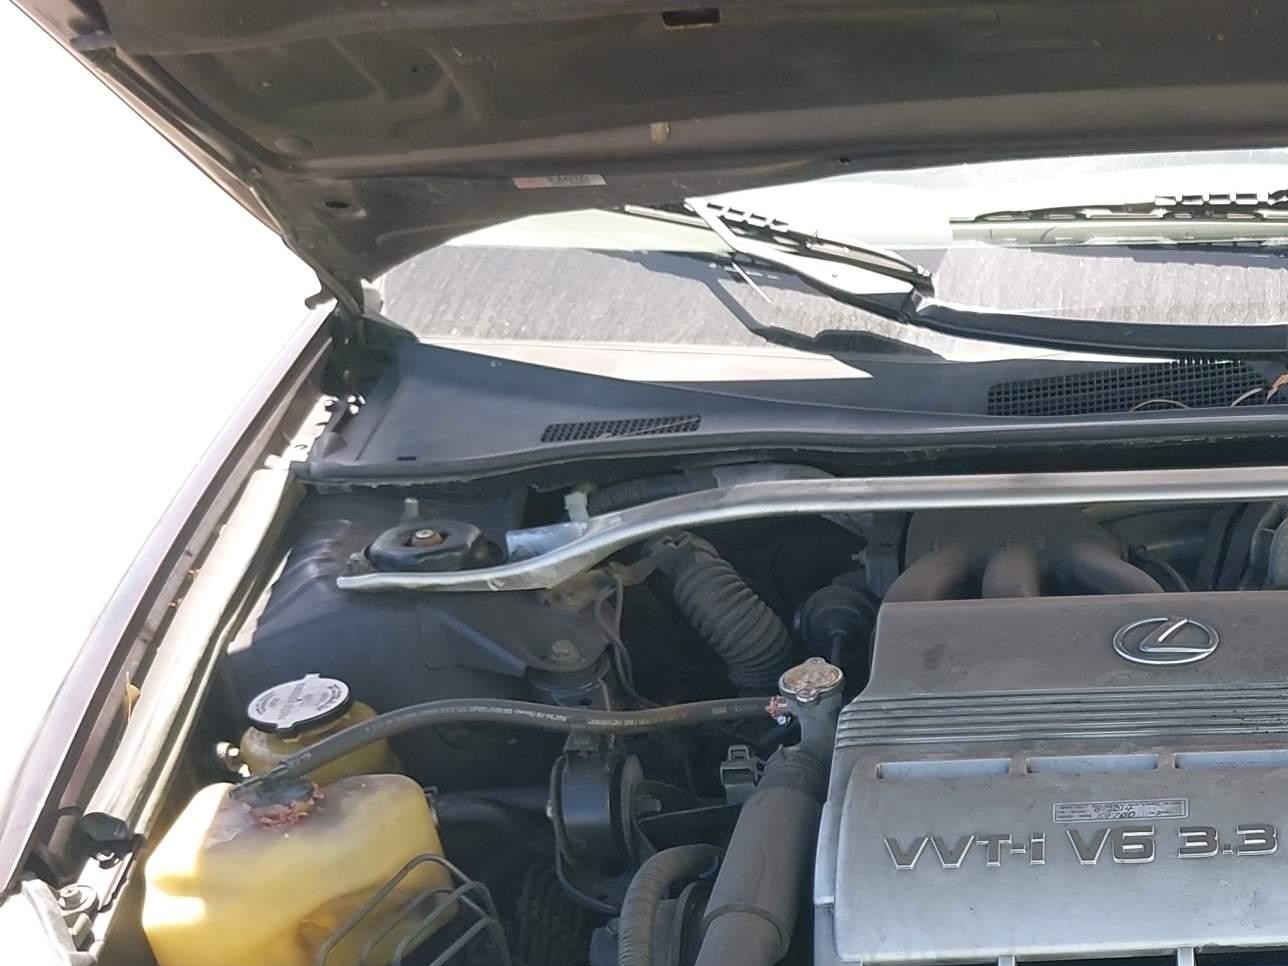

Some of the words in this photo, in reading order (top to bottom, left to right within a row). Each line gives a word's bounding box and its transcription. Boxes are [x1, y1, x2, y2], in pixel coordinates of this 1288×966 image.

[884, 832, 1046, 870] VVT-i
[1067, 824, 1156, 865] V6
[1178, 823, 1278, 858] 3.3
